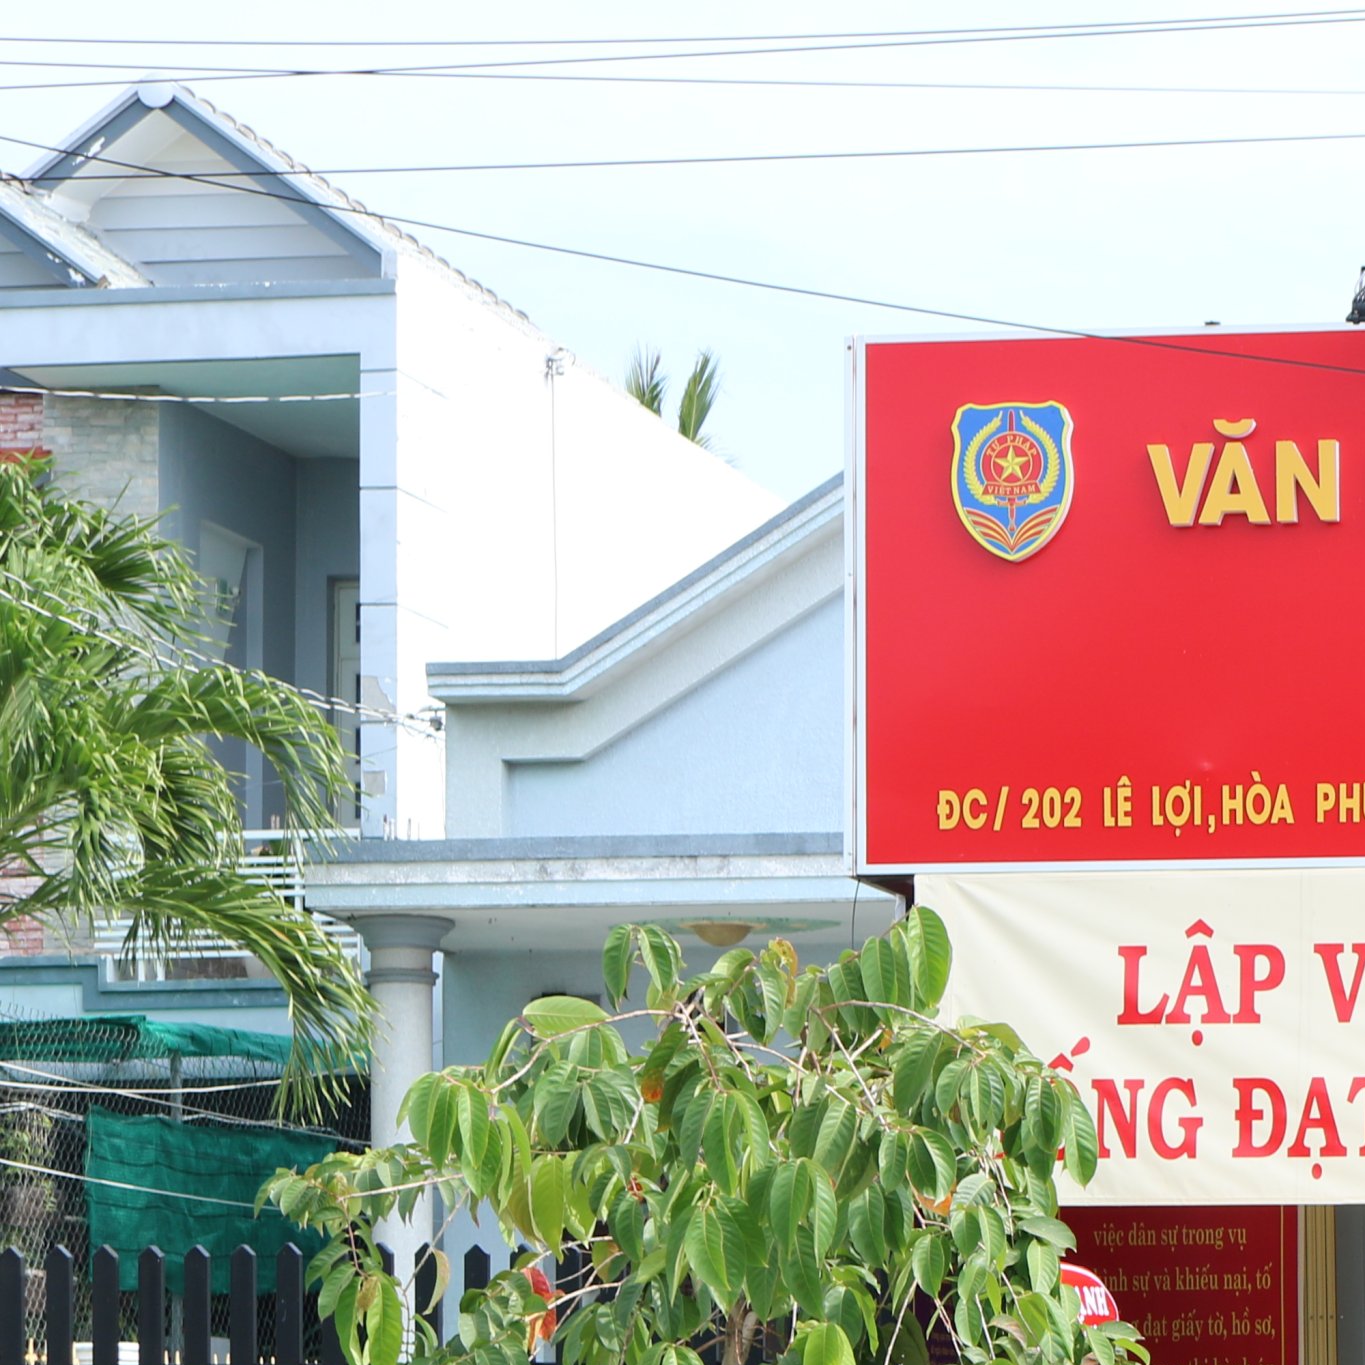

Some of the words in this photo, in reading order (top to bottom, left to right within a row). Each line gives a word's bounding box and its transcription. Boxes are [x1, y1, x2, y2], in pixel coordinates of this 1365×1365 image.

[1147, 417, 1339, 525] VĂN
[1022, 788, 1081, 827] 202
[1104, 776, 1131, 826] LÊ
[1118, 919, 1285, 1045] LẬP
[1093, 1223, 1124, 1252] việc
[1128, 1222, 1156, 1246] dân
[1161, 1226, 1180, 1252] sự
[1182, 1229, 1224, 1250] trong
[1228, 1227, 1248, 1250] vụ
[1132, 1272, 1152, 1299] sự
[1153, 1270, 1172, 1292] và
[1175, 1263, 1219, 1291] khiếu
[1223, 1271, 1252, 1297] nại,
[1256, 1262, 1274, 1290] tố
[1143, 1312, 1168, 1340] đạt
[1171, 1309, 1204, 1342] giấy
[1208, 1314, 1228, 1340] tờ,
[1231, 1305, 1252, 1336] hồ
